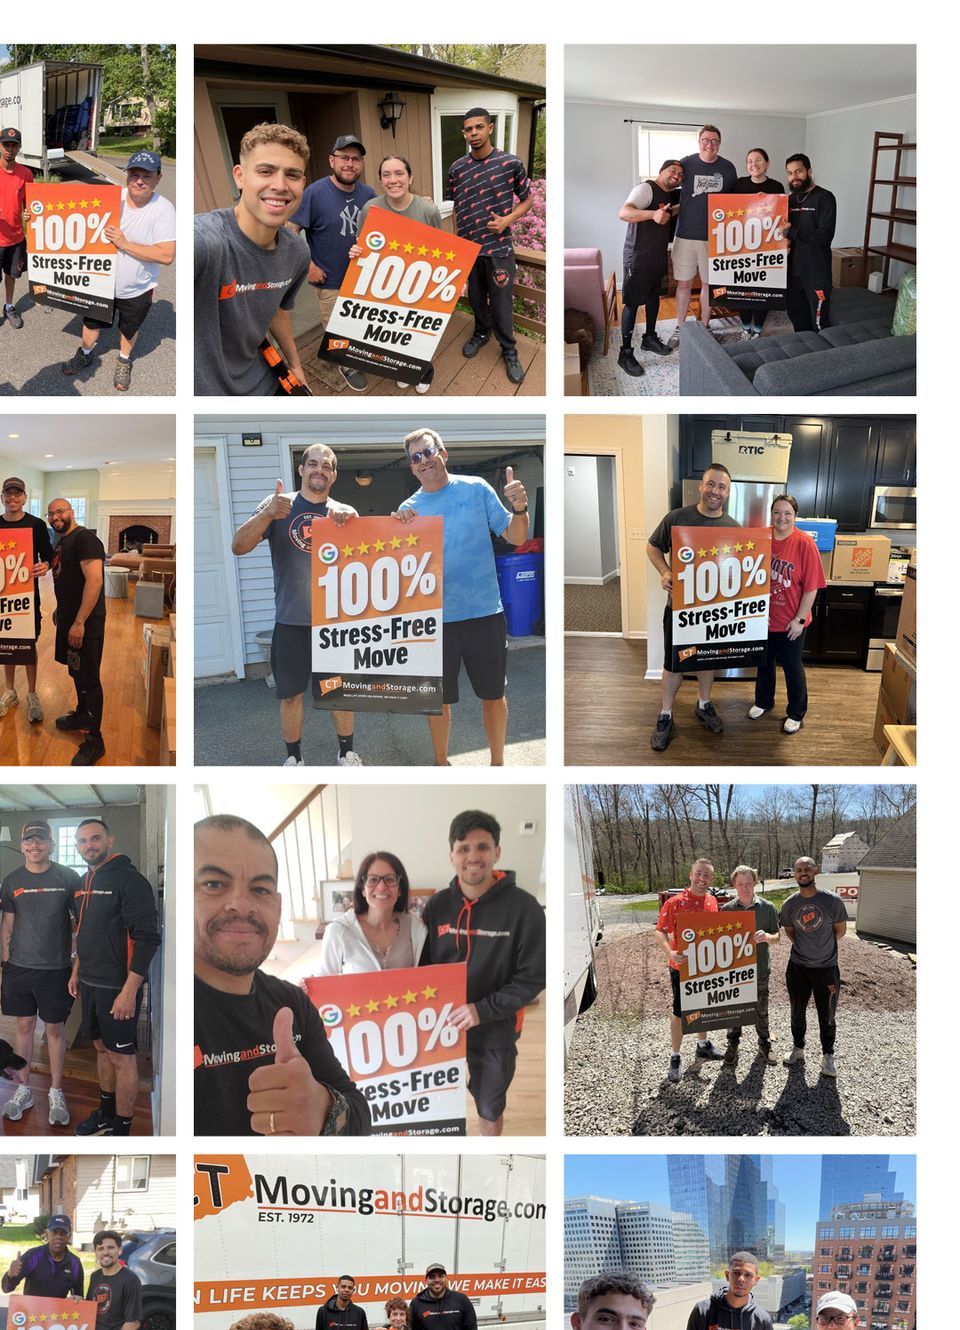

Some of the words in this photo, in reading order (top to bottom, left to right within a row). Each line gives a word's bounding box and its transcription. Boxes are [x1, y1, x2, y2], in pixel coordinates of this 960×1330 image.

[31, 213, 111, 251] 100%
[712, 216, 784, 254] 100%
[32, 254, 112, 273] Stress-Free
[712, 253, 784, 272] Stress-Free
[53, 271, 90, 287] Move
[353, 252, 463, 304] 100%
[339, 299, 445, 333] Stress-Free
[347, 345, 424, 372] MovingandStorage.com
[738, 445, 764, 455] RTIC
[318, 551, 437, 620] 100%
[678, 553, 767, 605] 100%
[678, 599, 767, 628] Stress-Free
[319, 616, 437, 650] Stress-Free
[353, 646, 408, 670] Move
[342, 682, 436, 694] MovingandStorage.com
[682, 930, 754, 977] 100%
[685, 967, 755, 996] Stress-Free
[258, 1212, 285, 1223] EST.
[287, 1212, 314, 1224] 1972
[208, 1286, 255, 1305] LIFE
[262, 1281, 326, 1303] KEEPS
[447, 1278, 470, 1293] WE
[472, 1276, 505, 1292] MAKE
[507, 1276, 520, 1290] IT
